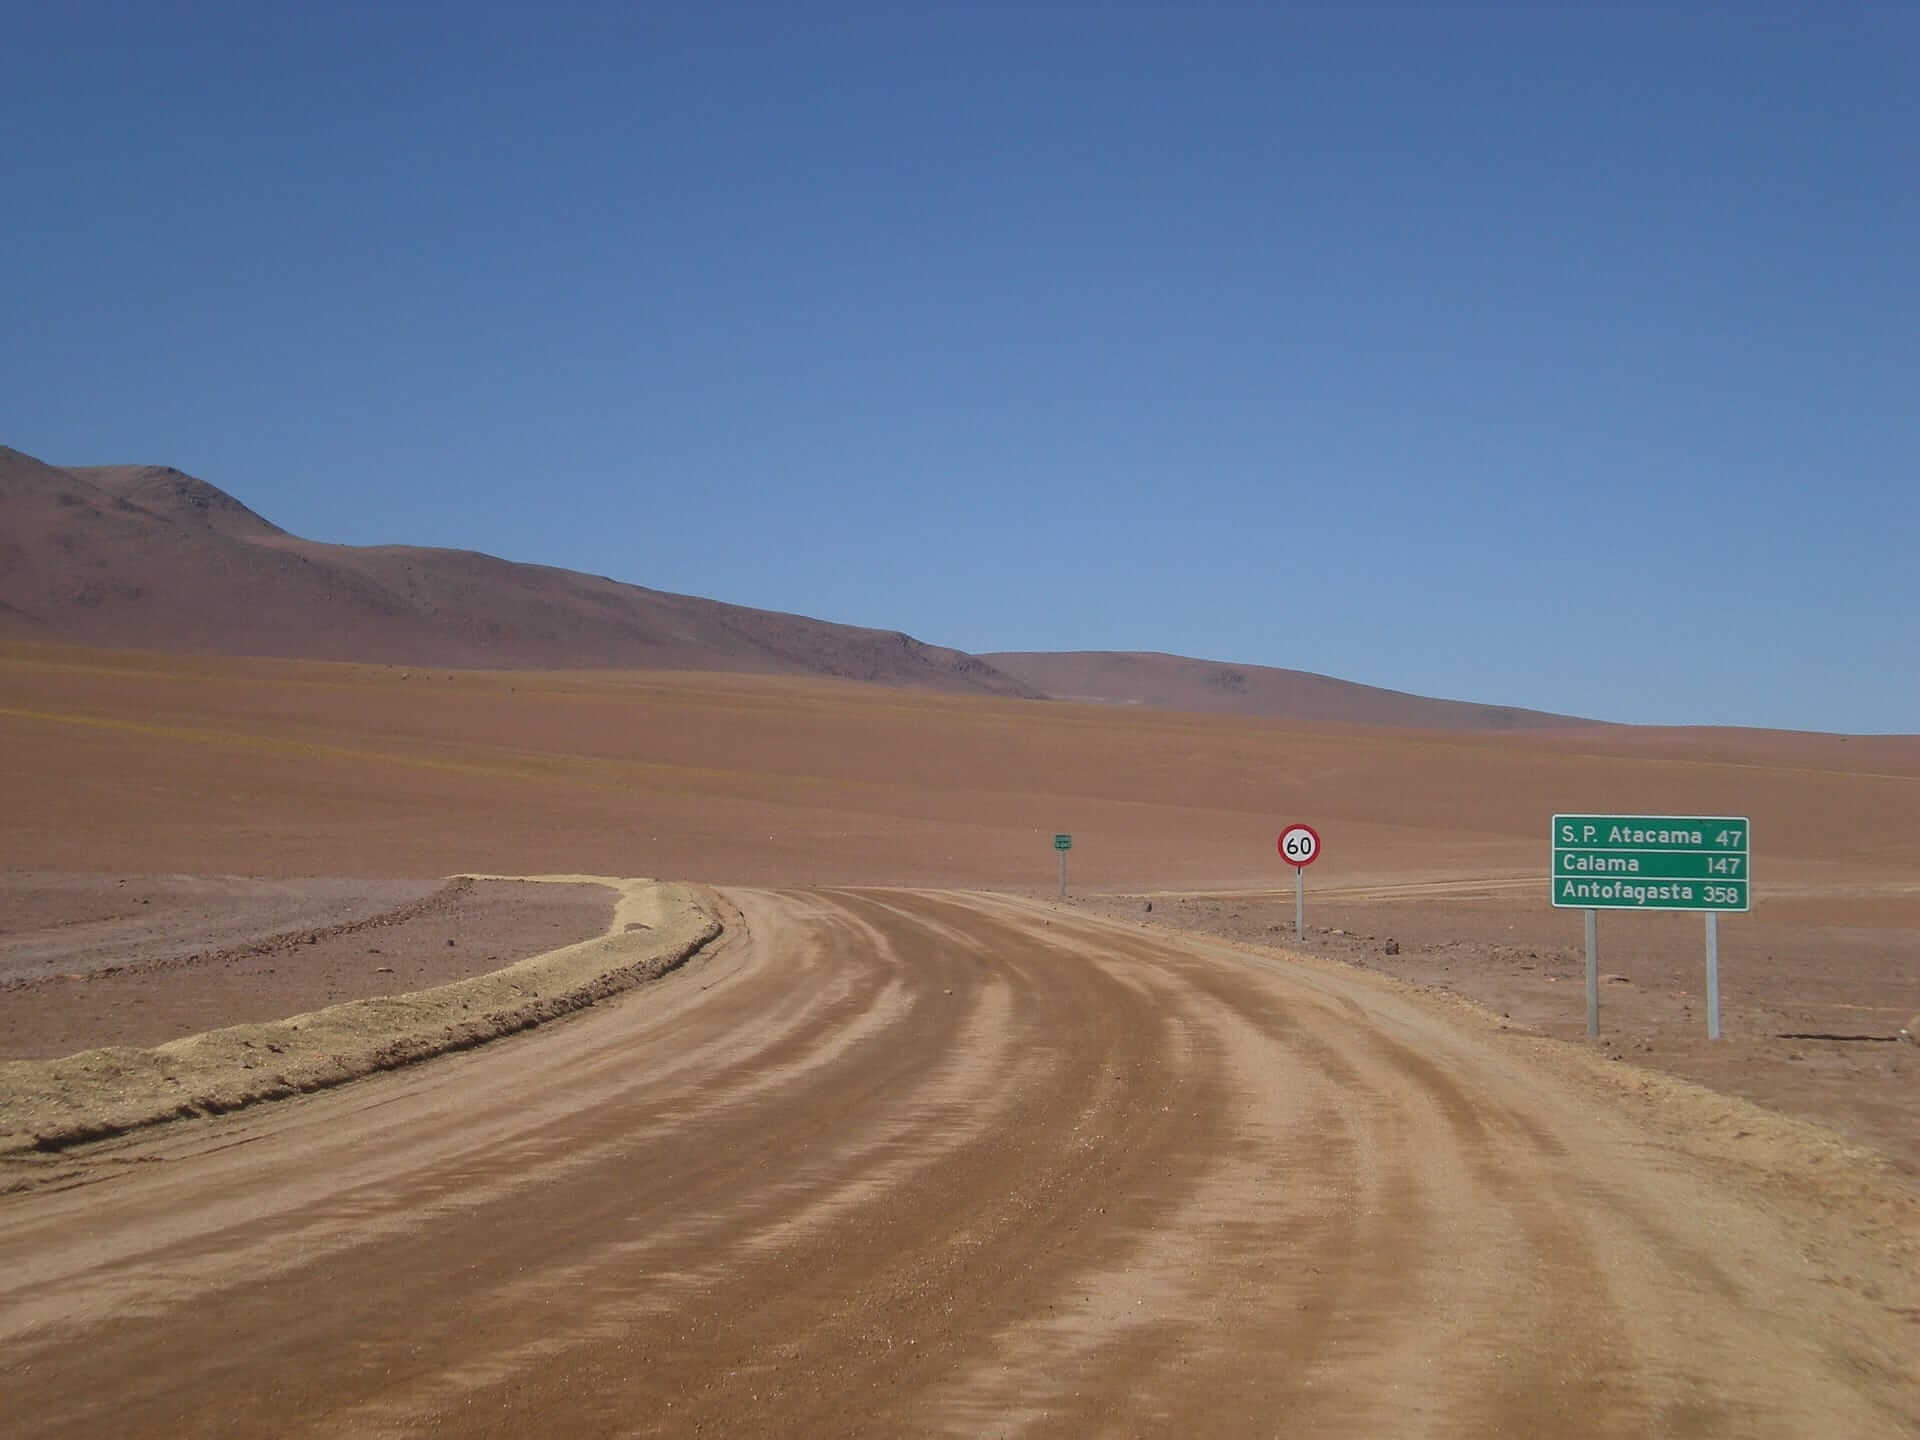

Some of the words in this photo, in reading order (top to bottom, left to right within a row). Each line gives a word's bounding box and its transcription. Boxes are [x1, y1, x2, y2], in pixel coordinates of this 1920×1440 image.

[1287, 837, 1312, 855] 60
[1608, 826, 1702, 844] Atacama
[1714, 831, 1742, 848] 47
[1563, 854, 1640, 872] Calama
[1707, 858, 1741, 875] 147
[1562, 880, 1693, 905] Antofagasta
[1703, 886, 1739, 904] 358
